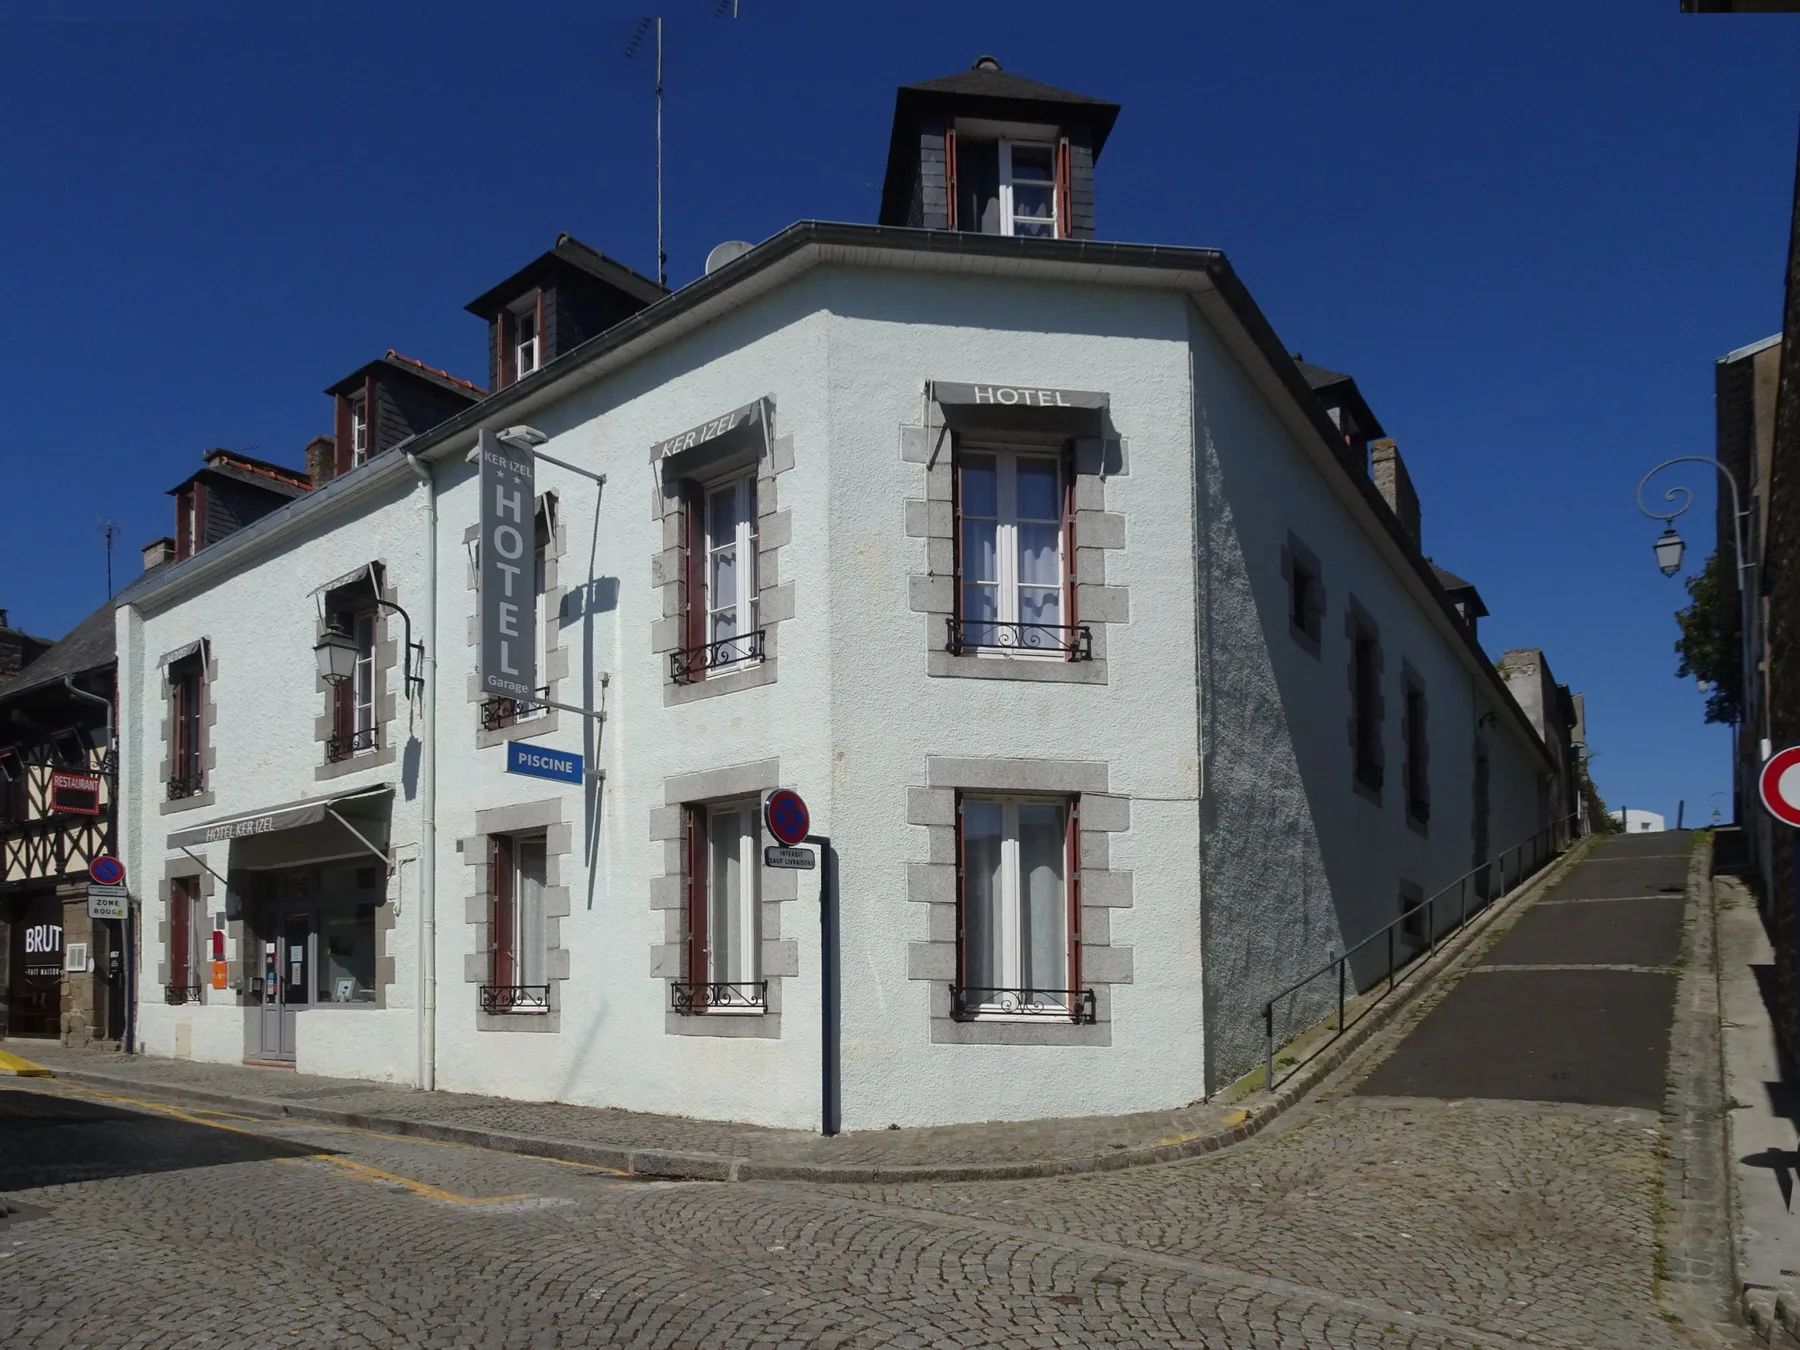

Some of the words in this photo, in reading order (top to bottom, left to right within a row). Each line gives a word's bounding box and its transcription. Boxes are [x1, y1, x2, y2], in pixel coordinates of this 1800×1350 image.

[974, 386, 1071, 407] HOTEL
[661, 431, 696, 458] KER
[700, 413, 737, 443] IZEL
[484, 451, 507, 469] KER
[510, 460, 532, 478] IZEL
[494, 484, 523, 676] HOTEL
[488, 675, 528, 694] Garage
[518, 752, 573, 774] PISCINE
[54, 775, 99, 791] RESTAURANT
[206, 825, 235, 841] HOTEL
[236, 820, 253, 837] KER
[255, 816, 275, 834] IZEL
[93, 908, 123, 916] ROUG
[96, 899, 120, 907] ZONE
[26, 925, 62, 952] BRUT
